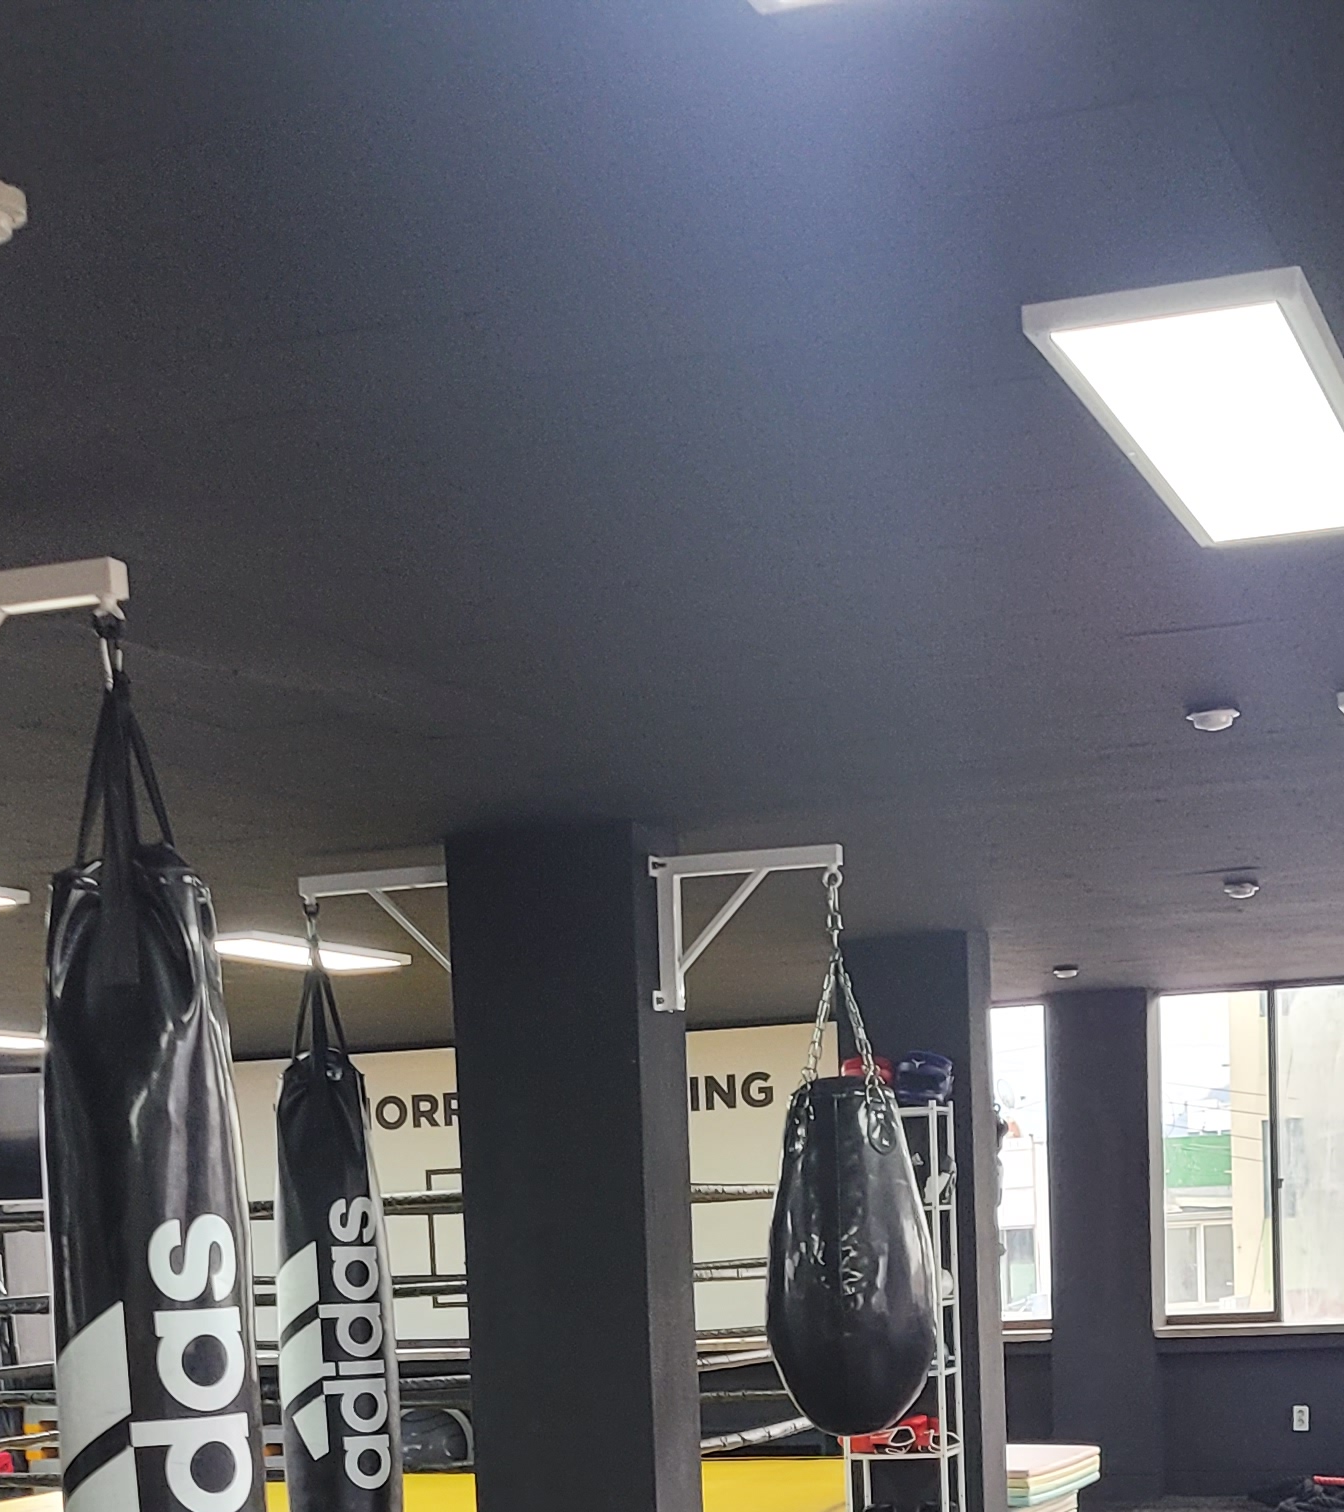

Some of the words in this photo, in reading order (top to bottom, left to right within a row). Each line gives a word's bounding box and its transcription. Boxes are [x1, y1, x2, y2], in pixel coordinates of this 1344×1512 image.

[366, 1092, 460, 1131] ORR
[689, 1071, 774, 1112] ING
[317, 1196, 392, 1490] adidas
